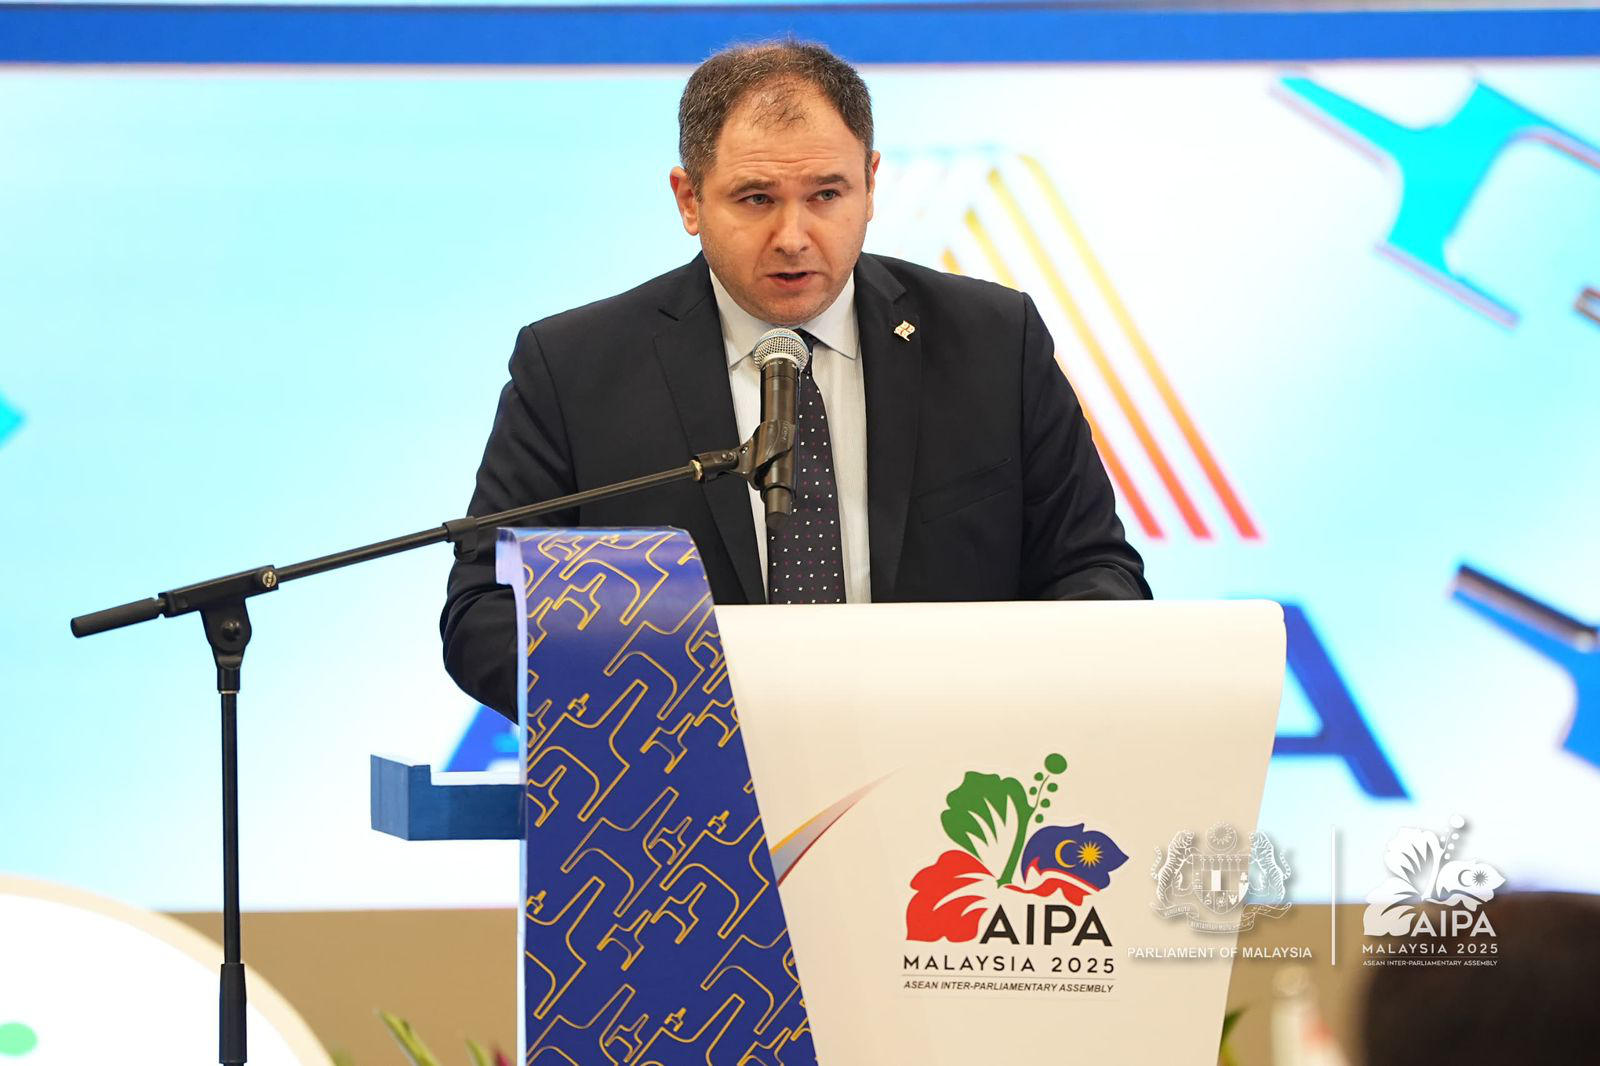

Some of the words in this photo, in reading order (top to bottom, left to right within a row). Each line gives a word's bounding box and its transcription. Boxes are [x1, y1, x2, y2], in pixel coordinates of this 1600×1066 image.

[979, 903, 1113, 947] AIPA
[903, 954, 1036, 972] MALAYSIA
[1051, 957, 1115, 974] 2025
[903, 980, 939, 990] ASEAN
[940, 981, 1058, 992] INTER-PARLIAMENTARY
[1058, 982, 1115, 994] ASSEMBLY
